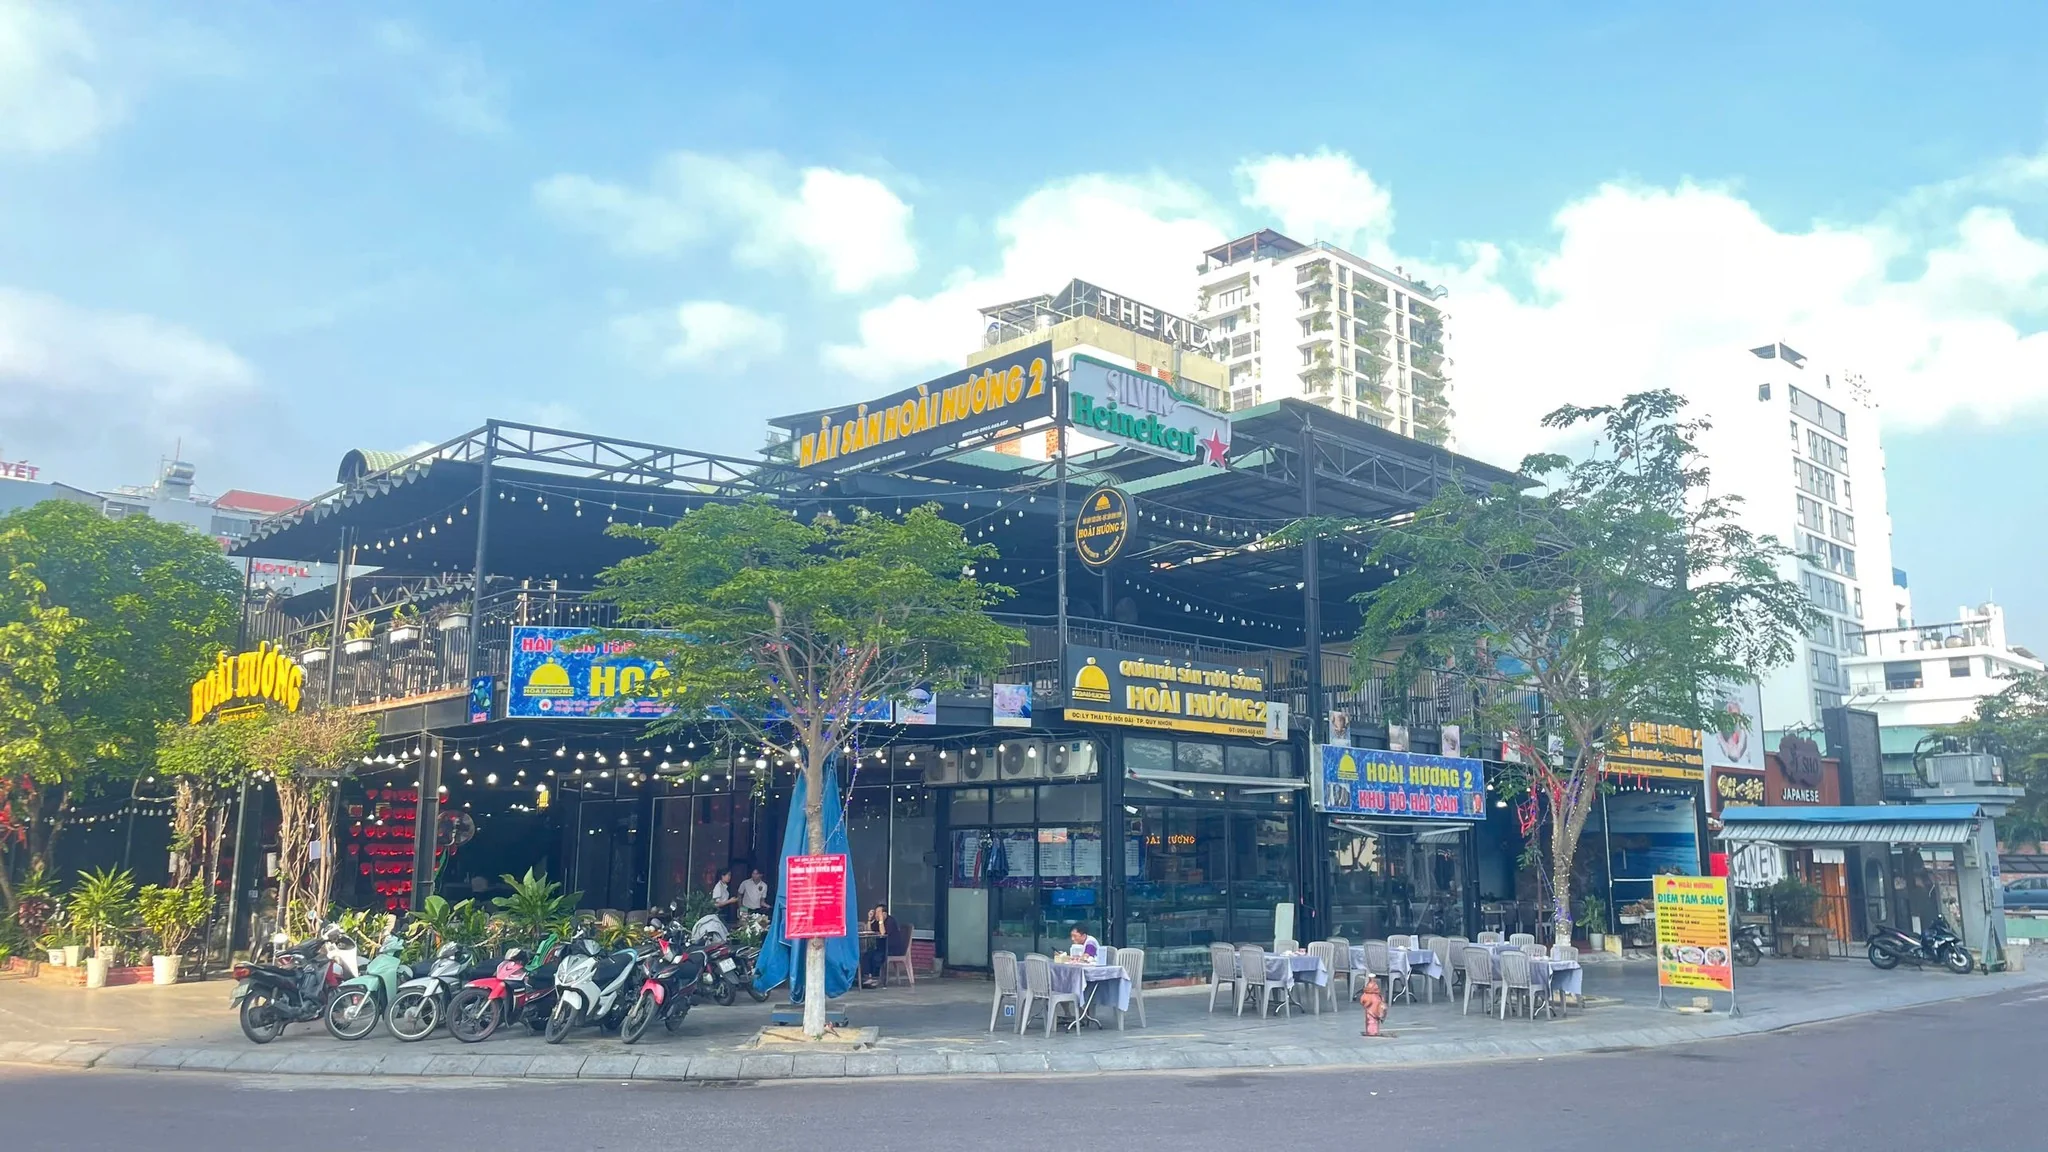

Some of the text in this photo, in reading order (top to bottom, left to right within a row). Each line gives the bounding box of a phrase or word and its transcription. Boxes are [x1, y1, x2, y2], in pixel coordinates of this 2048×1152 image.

[1100, 289, 1215, 353] THE KILA
[1106, 369, 1176, 417] SILVER
[800, 415, 841, 468] HẢI
[840, 403, 884, 455] SẢN
[883, 384, 941, 443] HOÀI
[940, 365, 1026, 423] HƯƠNG
[1026, 357, 1047, 398] 2
[1070, 391, 1197, 456] Heineken
[1178, 662, 1202, 684] SẢN
[1126, 682, 1180, 714] HOÀI
[1366, 760, 1473, 789] HOÀI HƯƠNG 2
[1358, 786, 1459, 814] KHU HỒ HẢI SẢN
[1783, 788, 1820, 803] JAPANESE
